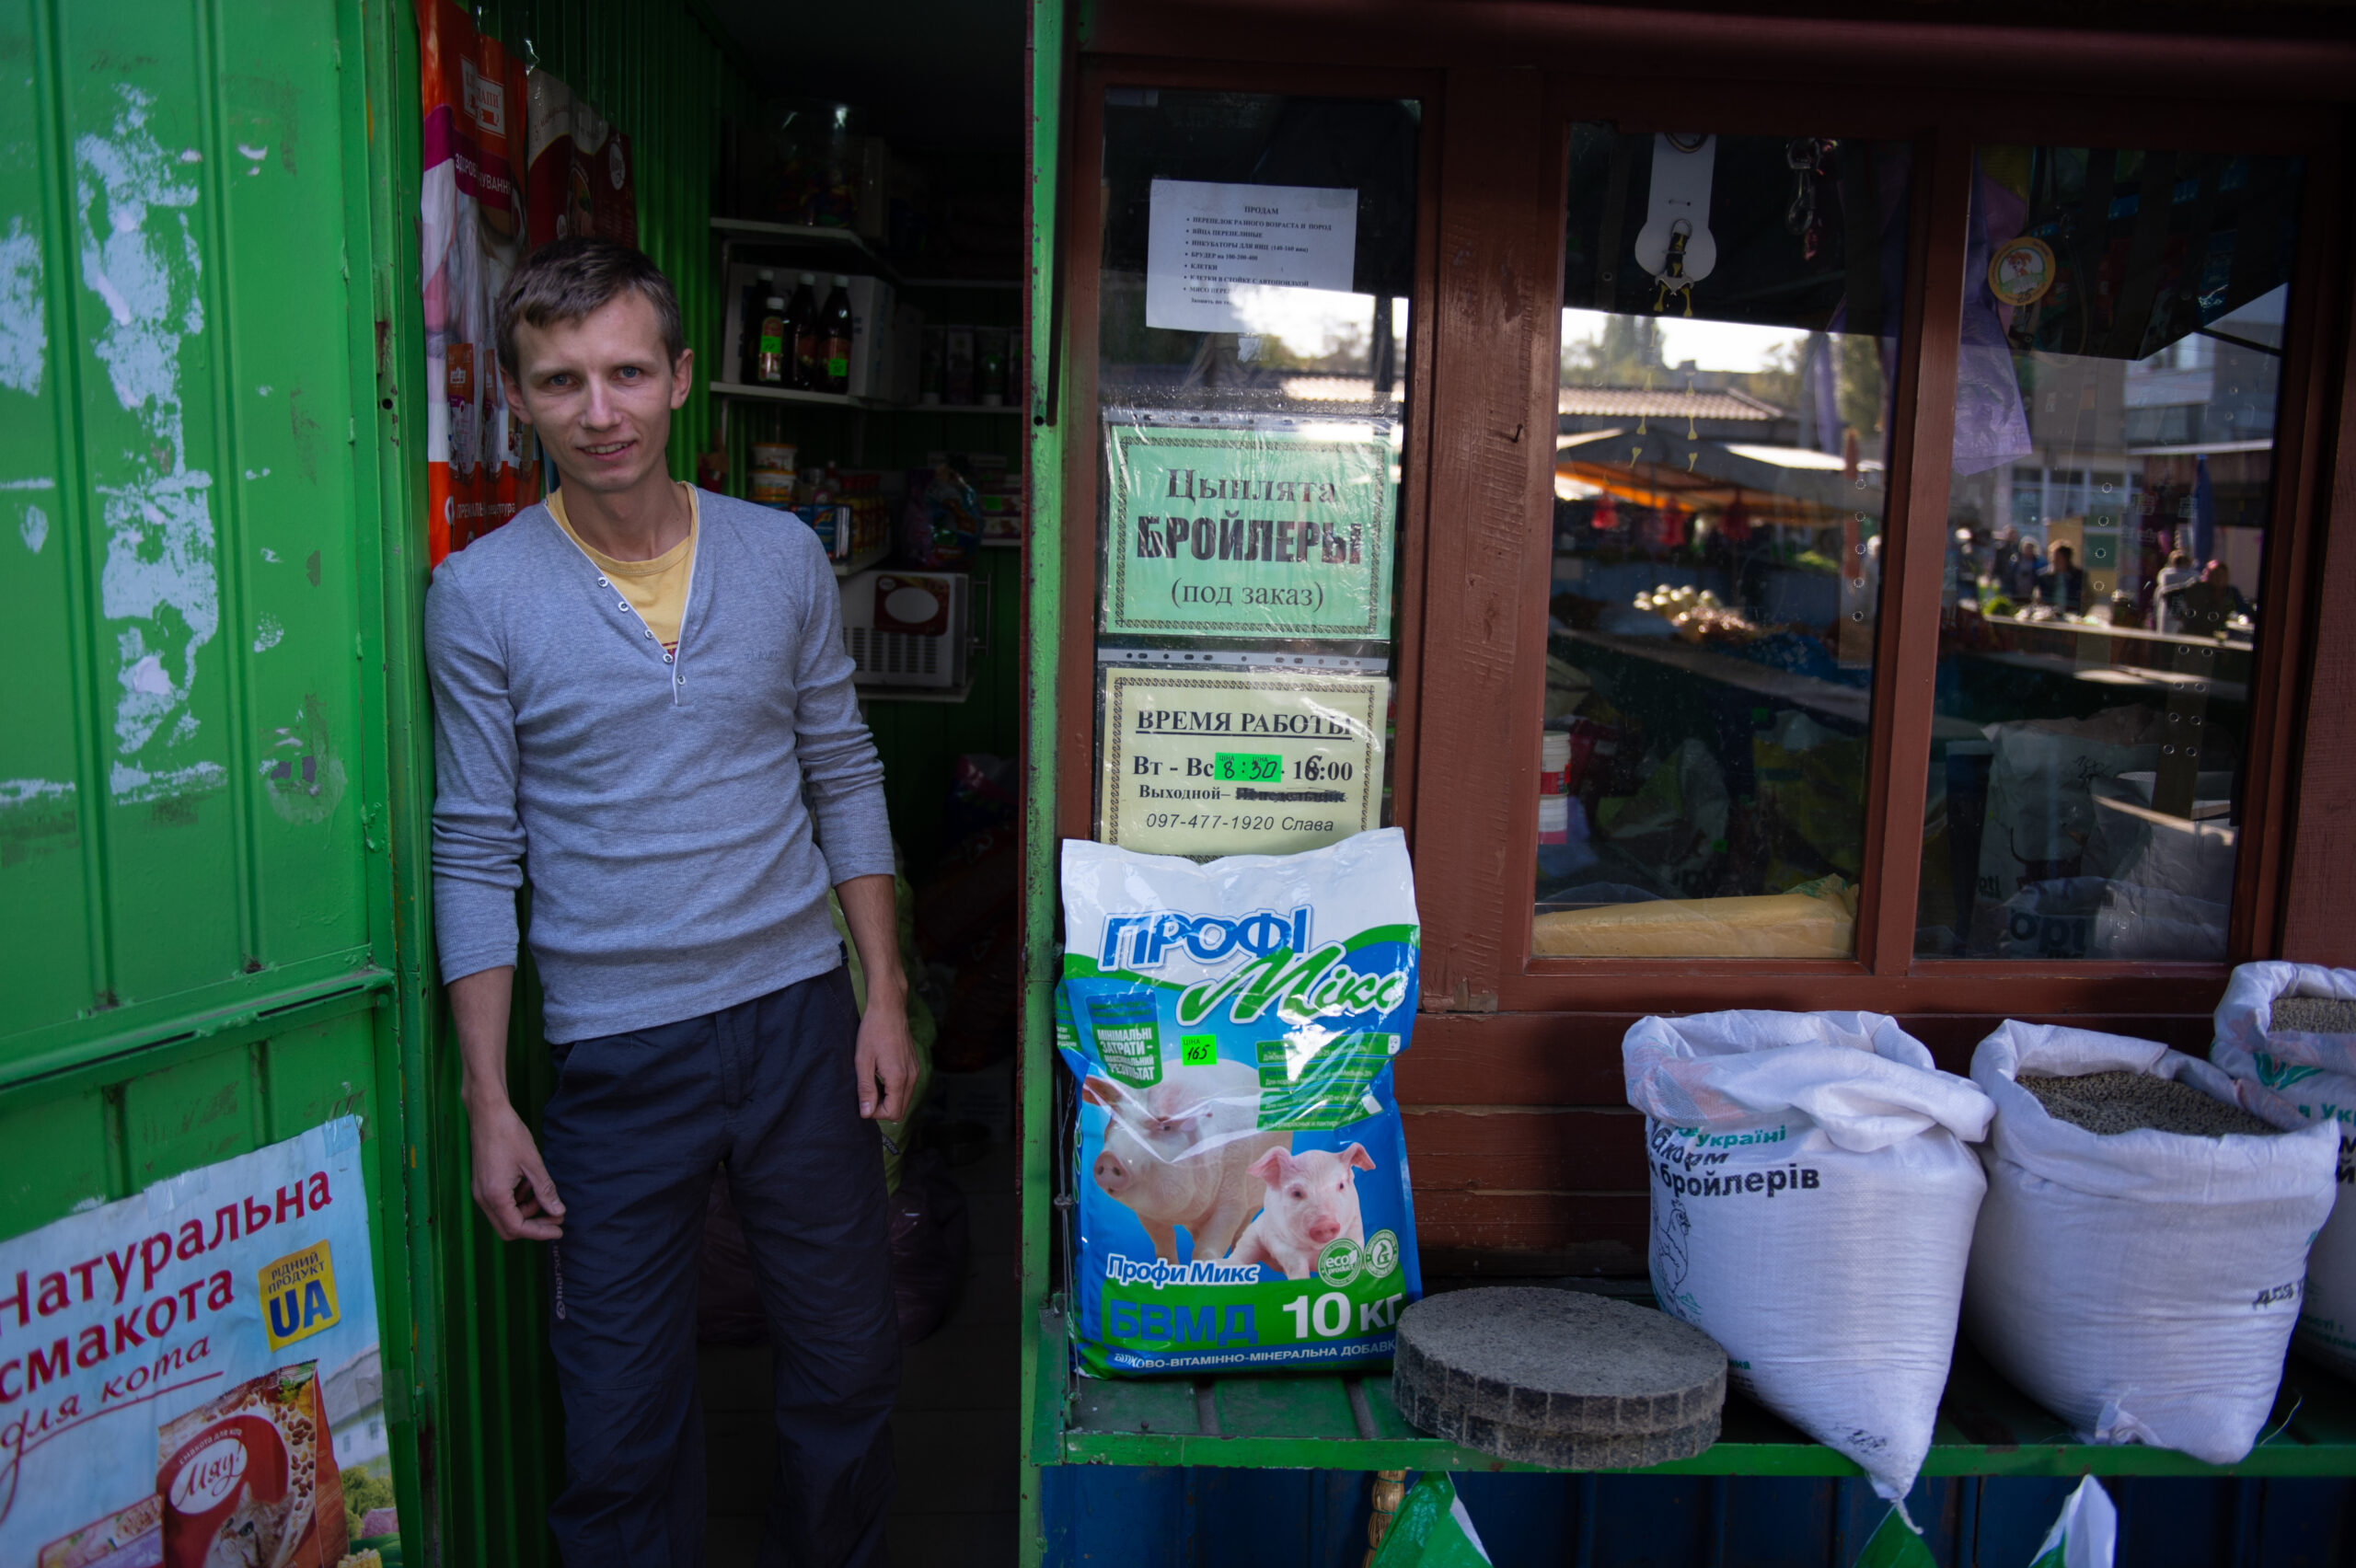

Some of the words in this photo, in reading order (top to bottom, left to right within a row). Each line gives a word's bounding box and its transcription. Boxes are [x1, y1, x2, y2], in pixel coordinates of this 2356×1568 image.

[1193, 216, 1233, 225] ПЕРЕПЕЛОК
[1234, 219, 1265, 227] РАЗНОГО
[1265, 221, 1299, 229] ВОЗРАСТА
[1309, 223, 1332, 232] ПОРОД
[1244, 206, 1279, 215] ПРОДАМ
[1191, 240, 1238, 249] ИНКУБАТОРЫ
[1191, 251, 1217, 259] БРУДЕР
[1190, 274, 1218, 282] КЛЕТКИ
[1224, 275, 1251, 284] СТОЙКЕ
[1165, 467, 1336, 506] Цыплята
[1137, 510, 1362, 565] БРОЙЛЕРЫ
[1171, 577, 1233, 609] (под
[1242, 582, 1323, 613] заказ)
[1137, 709, 1232, 732] ВРЕМЯ
[1241, 712, 1352, 735] РАБОТЫ
[1133, 755, 1163, 776] Вт
[1185, 756, 1215, 778] Вс
[1146, 813, 1274, 831] 097-477-1920
[1281, 816, 1334, 832] Слава
[1100, 906, 1311, 970] ПРОФІ
[1177, 943, 1407, 1026] Мікс
[1097, 1027, 1152, 1041] МІНІМАЛЬНІ
[1100, 1041, 1145, 1055] ЗАТРАТИ
[1187, 1044, 1210, 1061] 165
[1660, 1163, 1820, 1198] бройлерів
[0, 1170, 333, 1334] Натуральна
[271, 1251, 320, 1282] РІДНИЙ
[1325, 1254, 1349, 1268] eco
[268, 1263, 326, 1296] ПРОДУКТ
[1107, 1255, 1185, 1287] Профи
[1190, 1262, 1259, 1284] Микс
[269, 1279, 333, 1339] UA
[1110, 1298, 1259, 1345] БВМД
[1283, 1292, 1352, 1339] 10
[0, 1270, 235, 1404] смакота
[1340, 1341, 1397, 1358] ДОБАВК
[0, 1391, 83, 1495] для
[102, 1336, 212, 1403] кота
